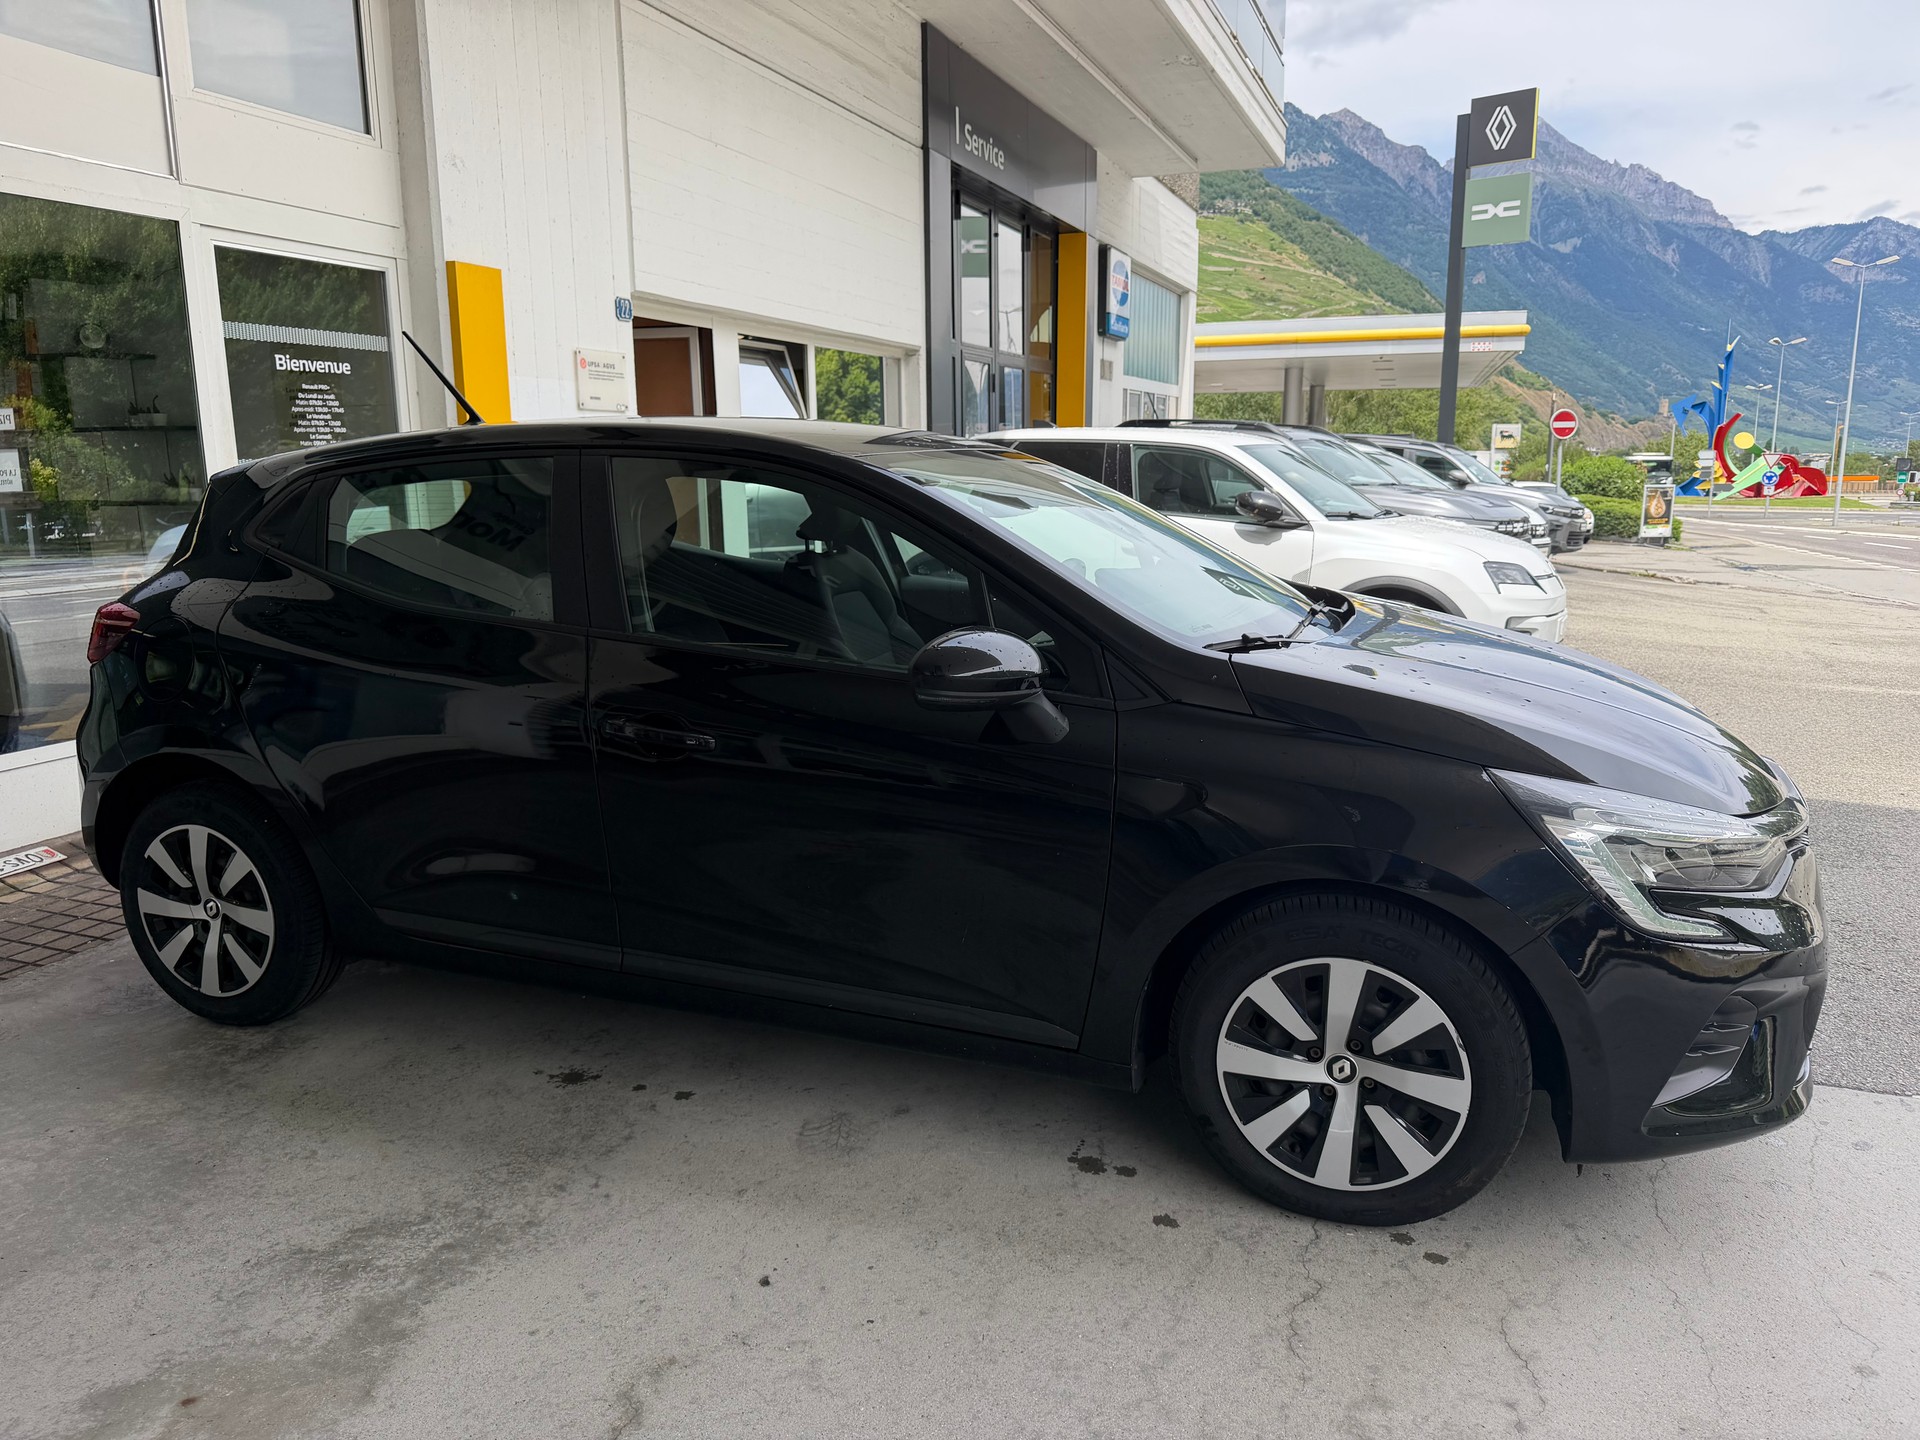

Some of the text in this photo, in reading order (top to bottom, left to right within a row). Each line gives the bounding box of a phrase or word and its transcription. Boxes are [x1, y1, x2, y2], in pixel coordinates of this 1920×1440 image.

[964, 123, 1005, 171] Service
[620, 299, 630, 319] 22
[274, 354, 352, 375] Bienvenue
